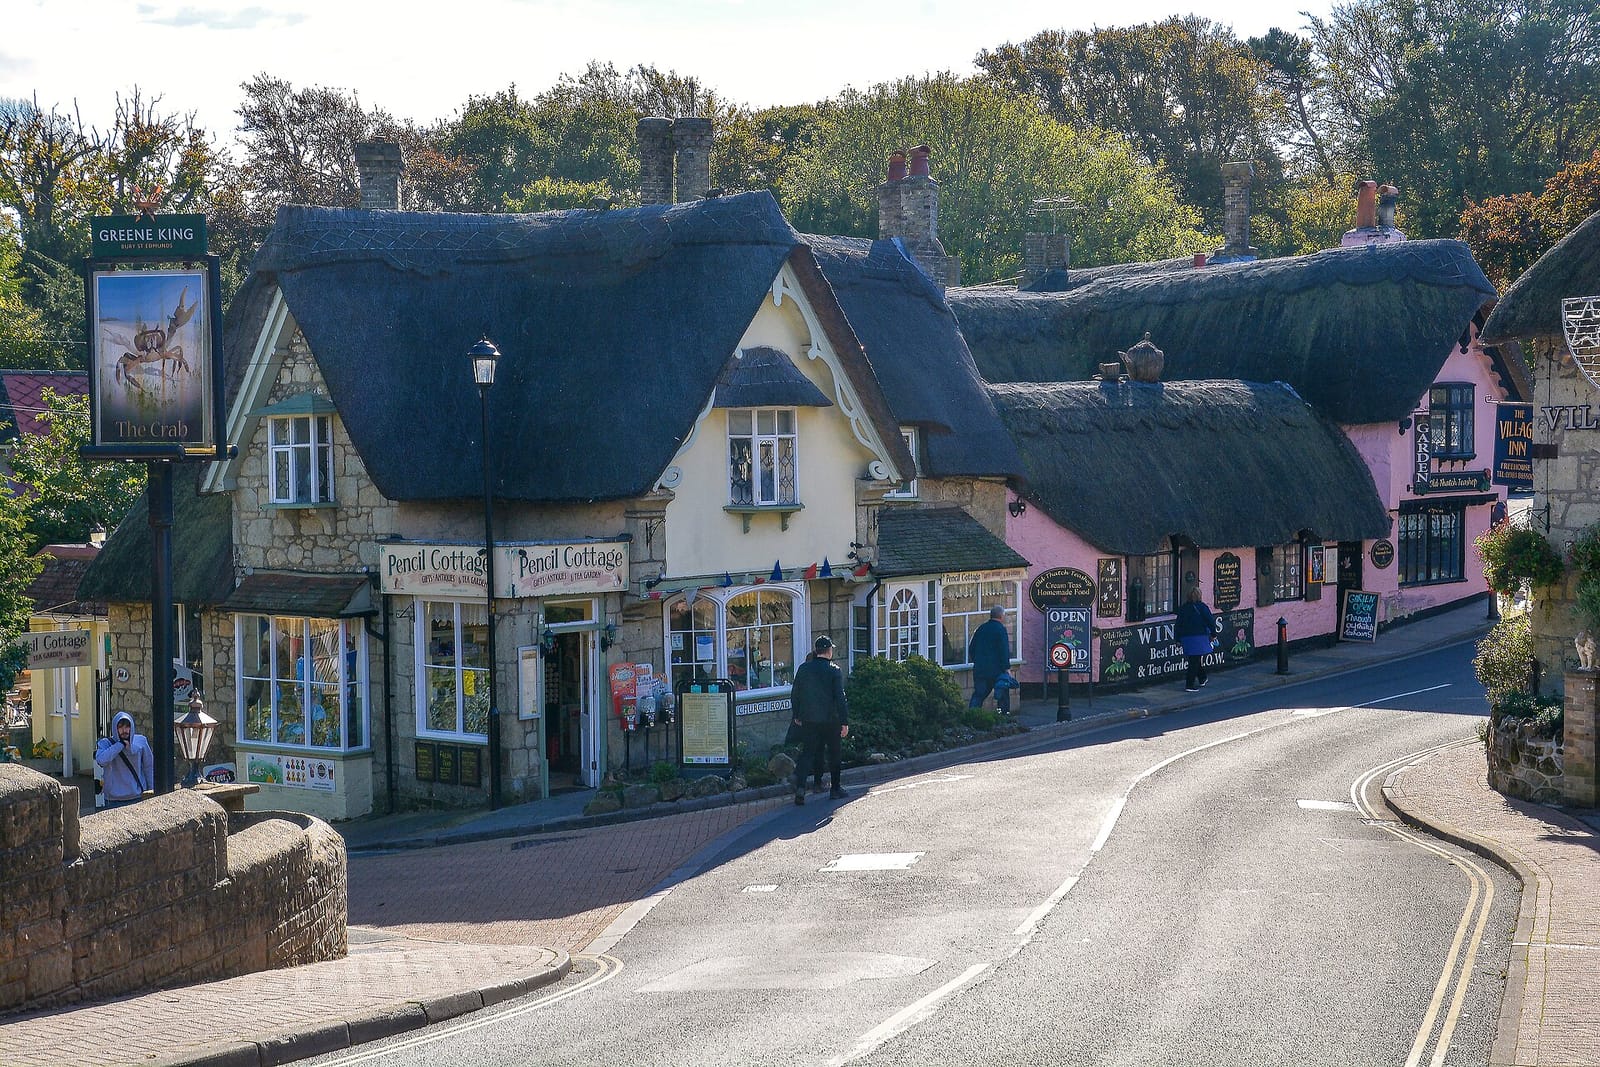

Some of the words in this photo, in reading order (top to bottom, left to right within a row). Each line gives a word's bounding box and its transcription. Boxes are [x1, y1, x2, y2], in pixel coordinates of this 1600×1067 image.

[99, 229, 153, 241] GREENE
[158, 228, 193, 240] KING
[1514, 410, 1525, 419] THE
[1541, 406, 1600, 430] VIL
[115, 420, 146, 437] The
[150, 420, 188, 437] Crab
[1500, 421, 1533, 441] VILLAG
[1416, 422, 1430, 483] GARDEN
[1508, 441, 1527, 456] INN
[1501, 463, 1531, 471] FREEHOUSE
[1440, 478, 1457, 487] Thatch
[1458, 477, 1477, 487] Teashop
[388, 549, 425, 576] Pencil
[431, 549, 488, 576] Cottage
[519, 548, 559, 577] Pencil
[564, 546, 623, 571] Cottage
[584, 571, 602, 579] GARDEN
[1045, 569, 1069, 579] Thatch
[1071, 570, 1092, 587] Teashop
[1050, 611, 1086, 622] OPEN
[1103, 631, 1115, 640] Old
[1115, 629, 1133, 639] Thatch
[43, 635, 87, 651] Cottage
[1109, 638, 1129, 647] Teashop
[1054, 650, 1067, 660] 20
[1150, 645, 1168, 660] Best
[1170, 644, 1184, 657] Tea
[1137, 665, 1145, 678] &
[1147, 663, 1162, 676] Tea
[1163, 658, 1189, 673] Garde
[738, 702, 769, 715] CHURCH
[770, 700, 790, 711] ROAD
